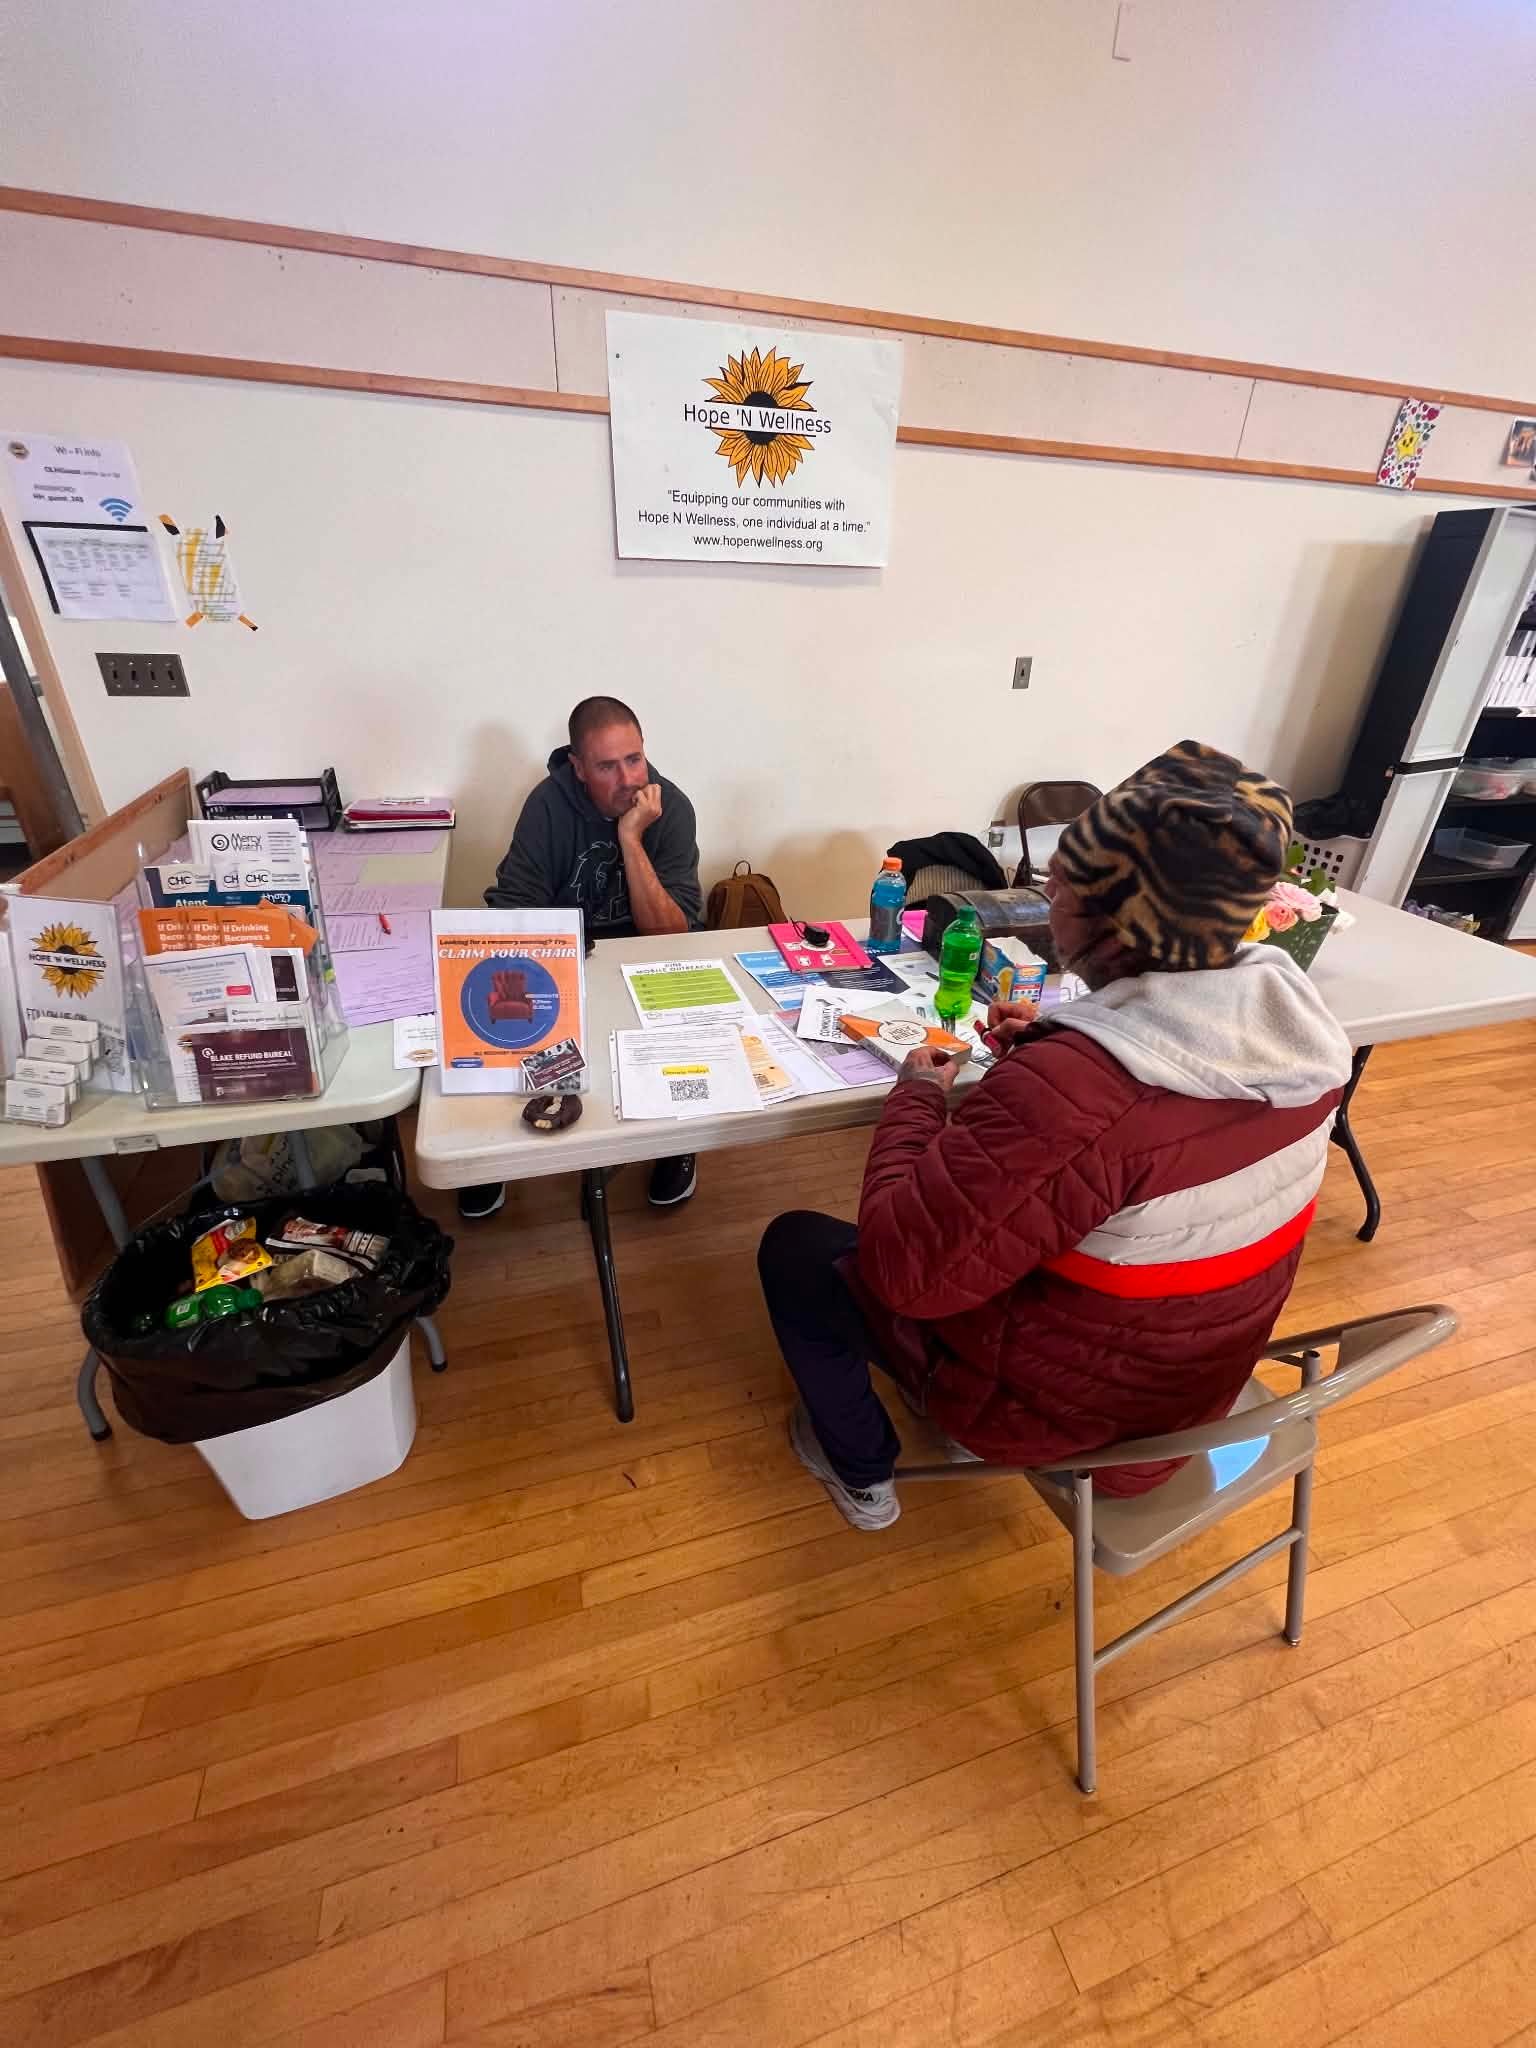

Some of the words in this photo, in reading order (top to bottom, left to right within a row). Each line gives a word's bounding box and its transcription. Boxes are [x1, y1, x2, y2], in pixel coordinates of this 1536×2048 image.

[684, 403, 730, 429] Hope
[736, 409, 752, 427] 'N
[759, 411, 831, 433] Wellness
[668, 489, 729, 508] "Equipping
[731, 496, 751, 506] our
[753, 497, 822, 510] communities
[824, 499, 846, 511] with
[638, 509, 670, 525] Hope
[673, 512, 682, 524] N
[685, 512, 739, 528] Wellness,
[742, 518, 763, 528] one
[766, 517, 817, 530] individual
[820, 520, 830, 531] at
[832, 521, 840, 531] a
[842, 520, 871, 533] time."
[693, 536, 824, 552] www.hopenwellness.org
[168, 876, 192, 886] CHC
[246, 874, 270, 884] CHC
[439, 947, 485, 959] CLAIM
[490, 947, 529, 958] YOUR
[532, 947, 577, 958] CHAIR
